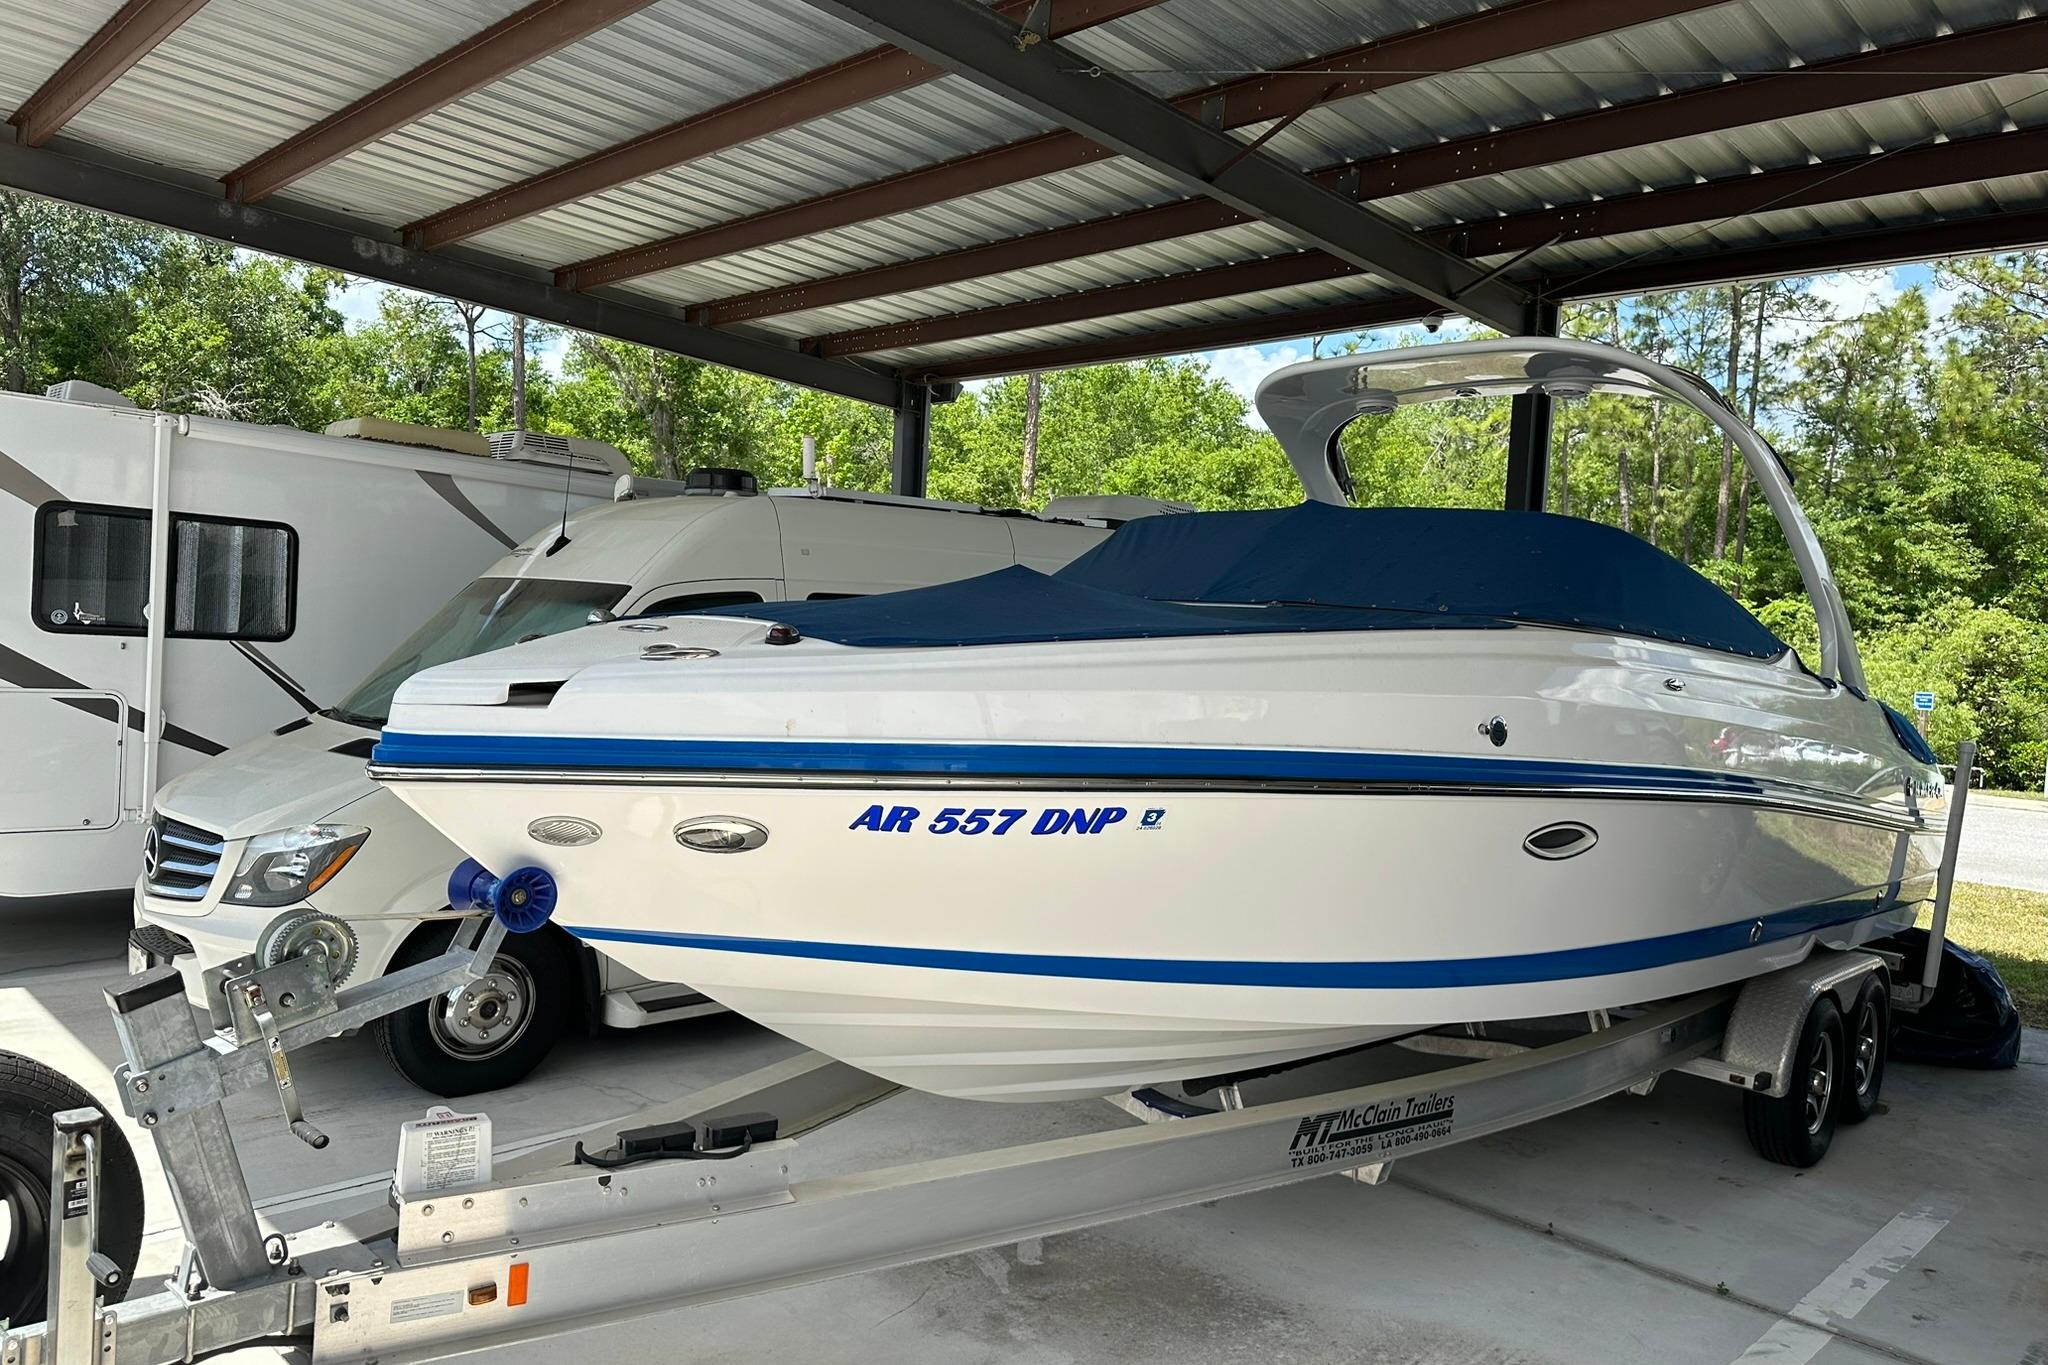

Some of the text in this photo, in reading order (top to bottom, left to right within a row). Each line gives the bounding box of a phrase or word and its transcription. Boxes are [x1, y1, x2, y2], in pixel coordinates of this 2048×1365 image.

[848, 804, 1128, 836] AR 557 DNP
[1146, 812, 1158, 822] 3
[1336, 1092, 1455, 1131] McClain Trailers
[1289, 1111, 1342, 1150] MT
[1291, 1125, 1452, 1168] TX 800-747-3059 LA 800-490-0664
[1328, 1140, 1351, 1150] FOR
[1355, 1136, 1374, 1145] THE
[1378, 1127, 1415, 1140] LONG
